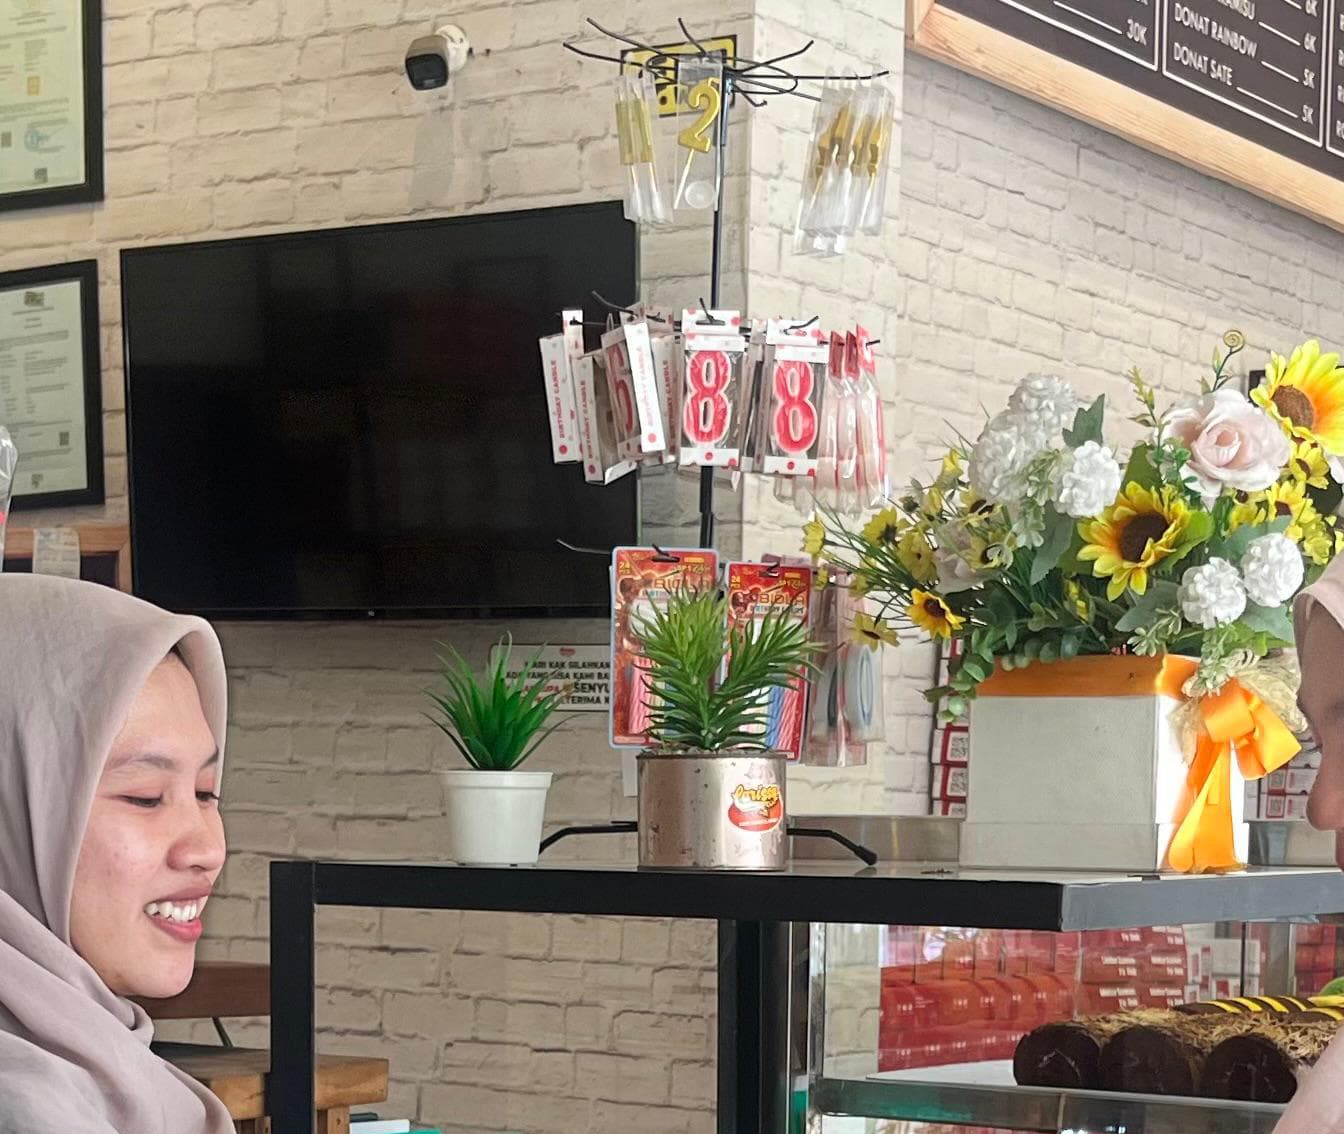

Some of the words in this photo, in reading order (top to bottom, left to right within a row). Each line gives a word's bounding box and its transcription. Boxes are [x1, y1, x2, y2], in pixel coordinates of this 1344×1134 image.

[1126, 18, 1147, 46] 30K
[1174, 3, 1210, 36] DONAT
[1211, 21, 1258, 58] RAINBOW
[1173, 42, 1208, 74] DONAT
[1210, 59, 1233, 86] SATE
